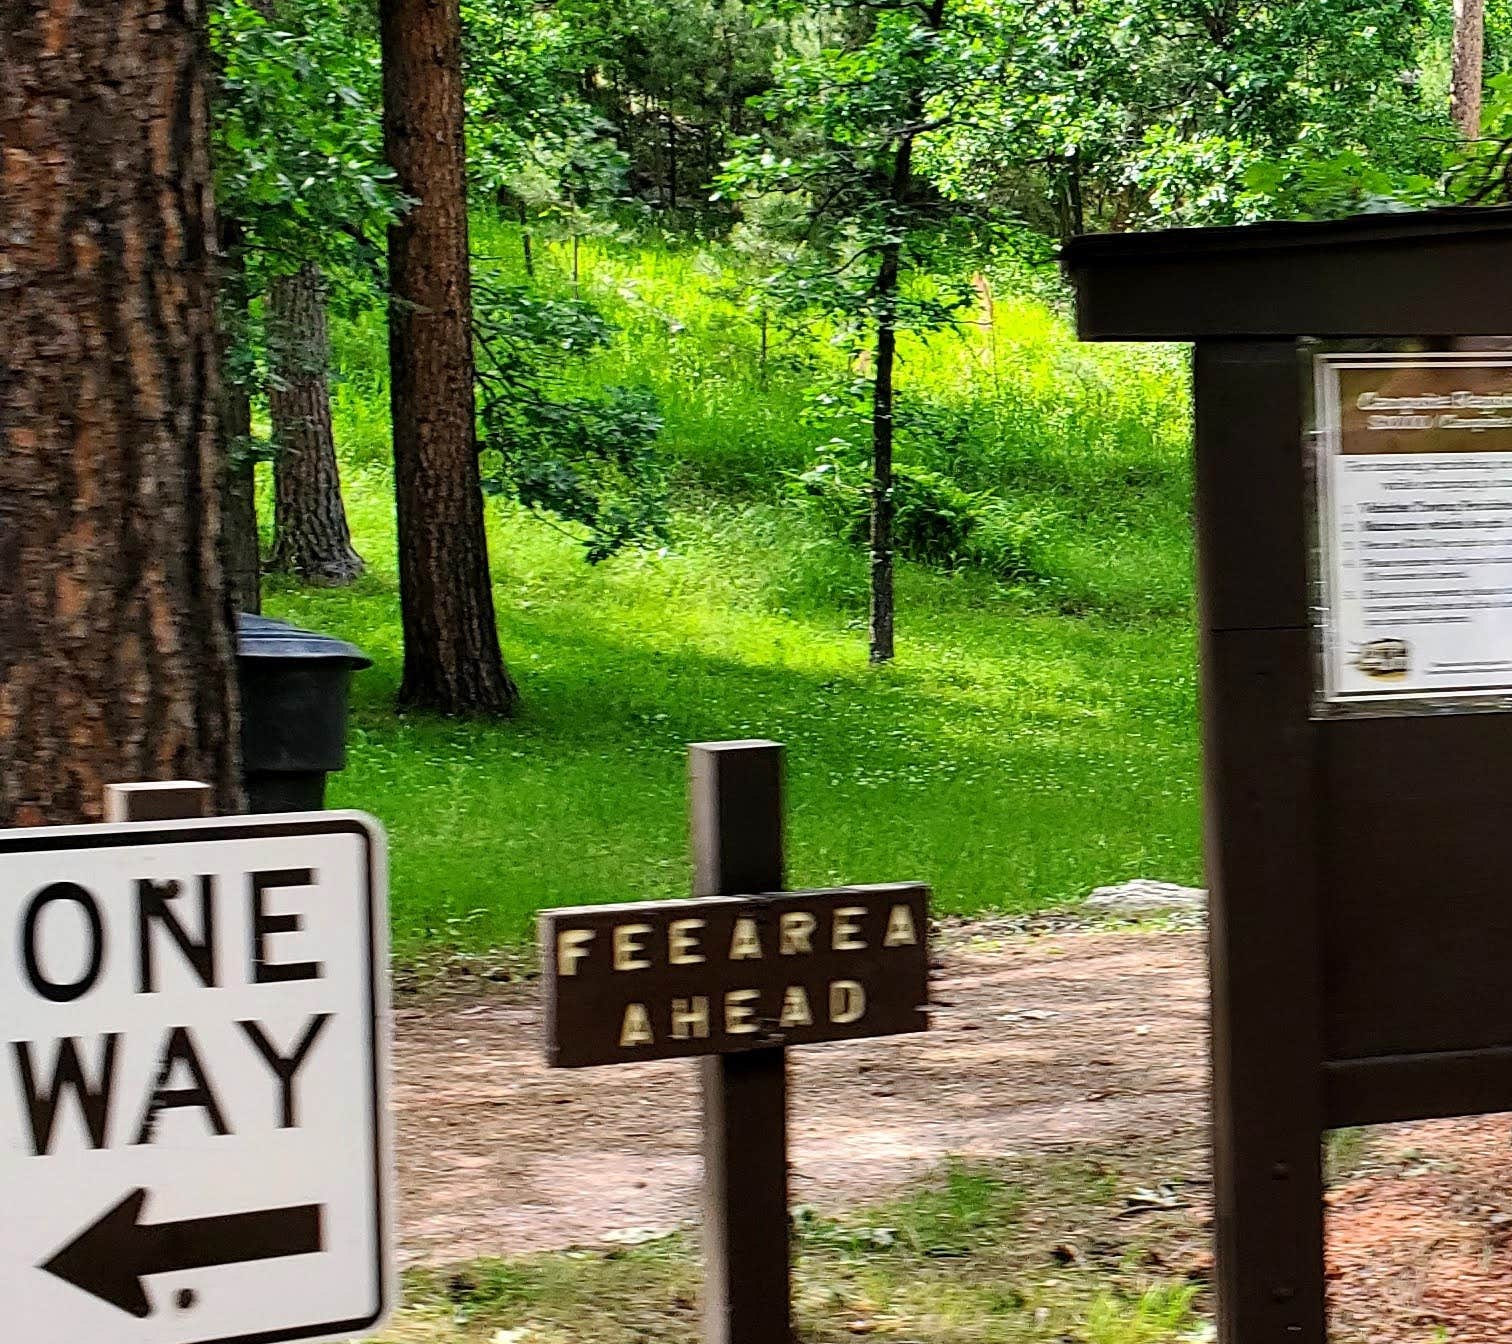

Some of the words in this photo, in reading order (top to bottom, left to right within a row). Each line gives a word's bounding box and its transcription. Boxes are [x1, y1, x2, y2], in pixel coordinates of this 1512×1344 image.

[18, 866, 327, 1003] ONE
[556, 917, 707, 977] FEE
[728, 902, 918, 960] AREA
[618, 978, 867, 1048] AHEAD
[8, 1012, 335, 1156] WAY
